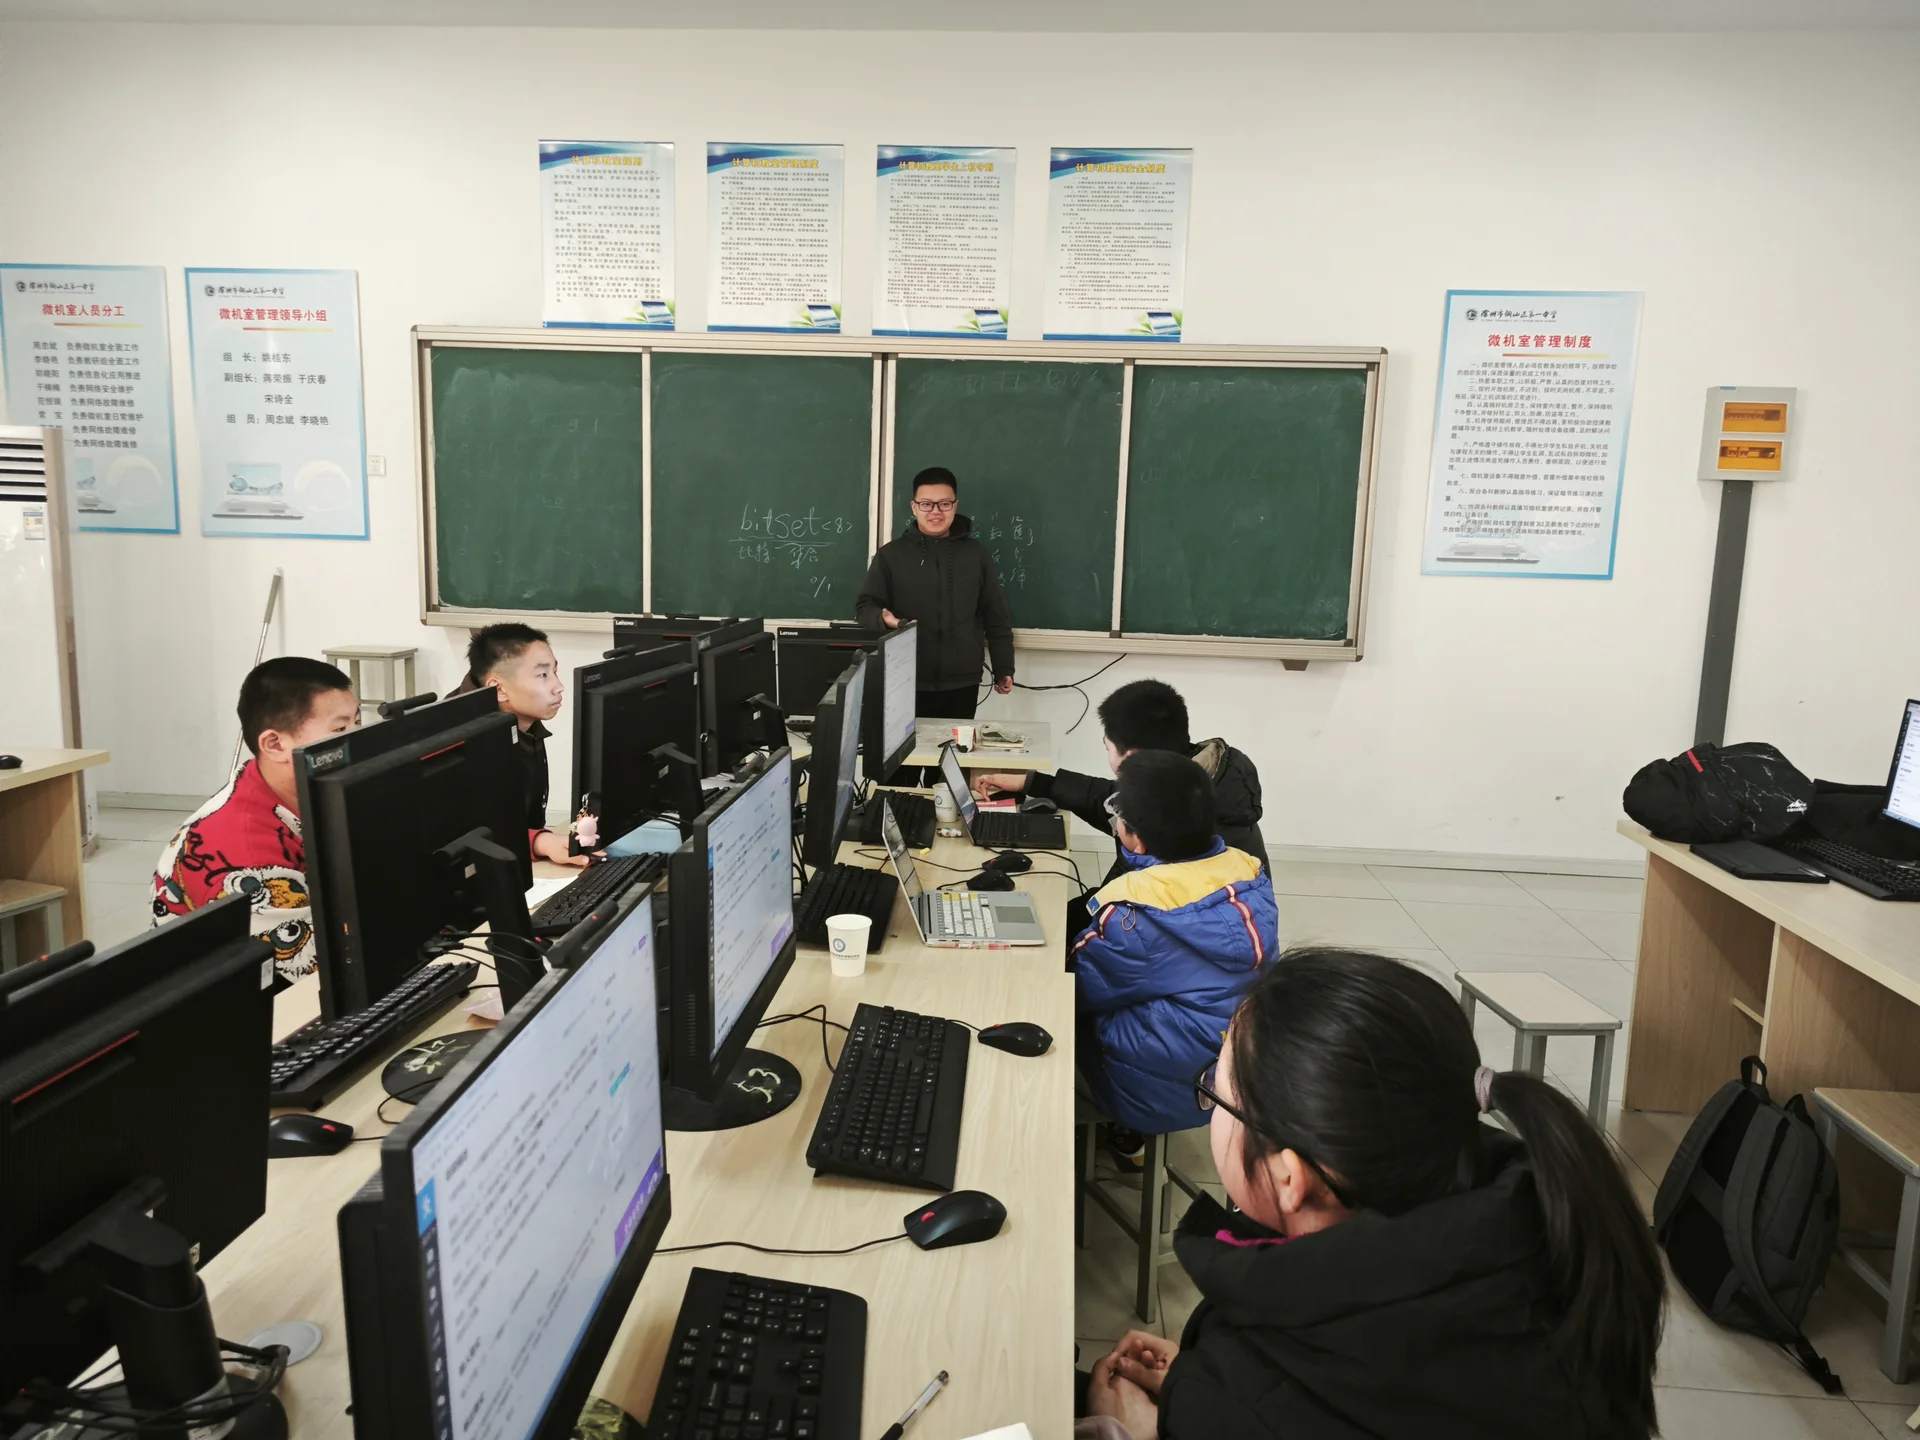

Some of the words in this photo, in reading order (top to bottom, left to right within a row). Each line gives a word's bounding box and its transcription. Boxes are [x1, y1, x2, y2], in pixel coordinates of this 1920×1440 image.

[42, 304, 126, 317] 微机室人员分工
[220, 308, 328, 322] 微机室管理领导小组
[1488, 334, 1592, 348] 微机室管理制度
[67, 342, 140, 352] 负责微机室全面工作
[68, 356, 140, 366] 负责教研组全面工作
[68, 370, 141, 380] 负责信息化应用推进
[298, 374, 326, 384] 于庆春
[70, 384, 134, 394] 负责网络安全维护
[71, 398, 135, 407] 负责网络故障维修
[264, 394, 293, 405] 宋诗全
[72, 412, 144, 422] 负责微机室日常维护
[266, 415, 294, 425] 周忠斌
[300, 416, 328, 426] 李晓艳
[73, 426, 136, 435] 负责网络故障维修
[74, 439, 138, 449] 负责网络故障维修
[311, 750, 343, 768] Lenovo
